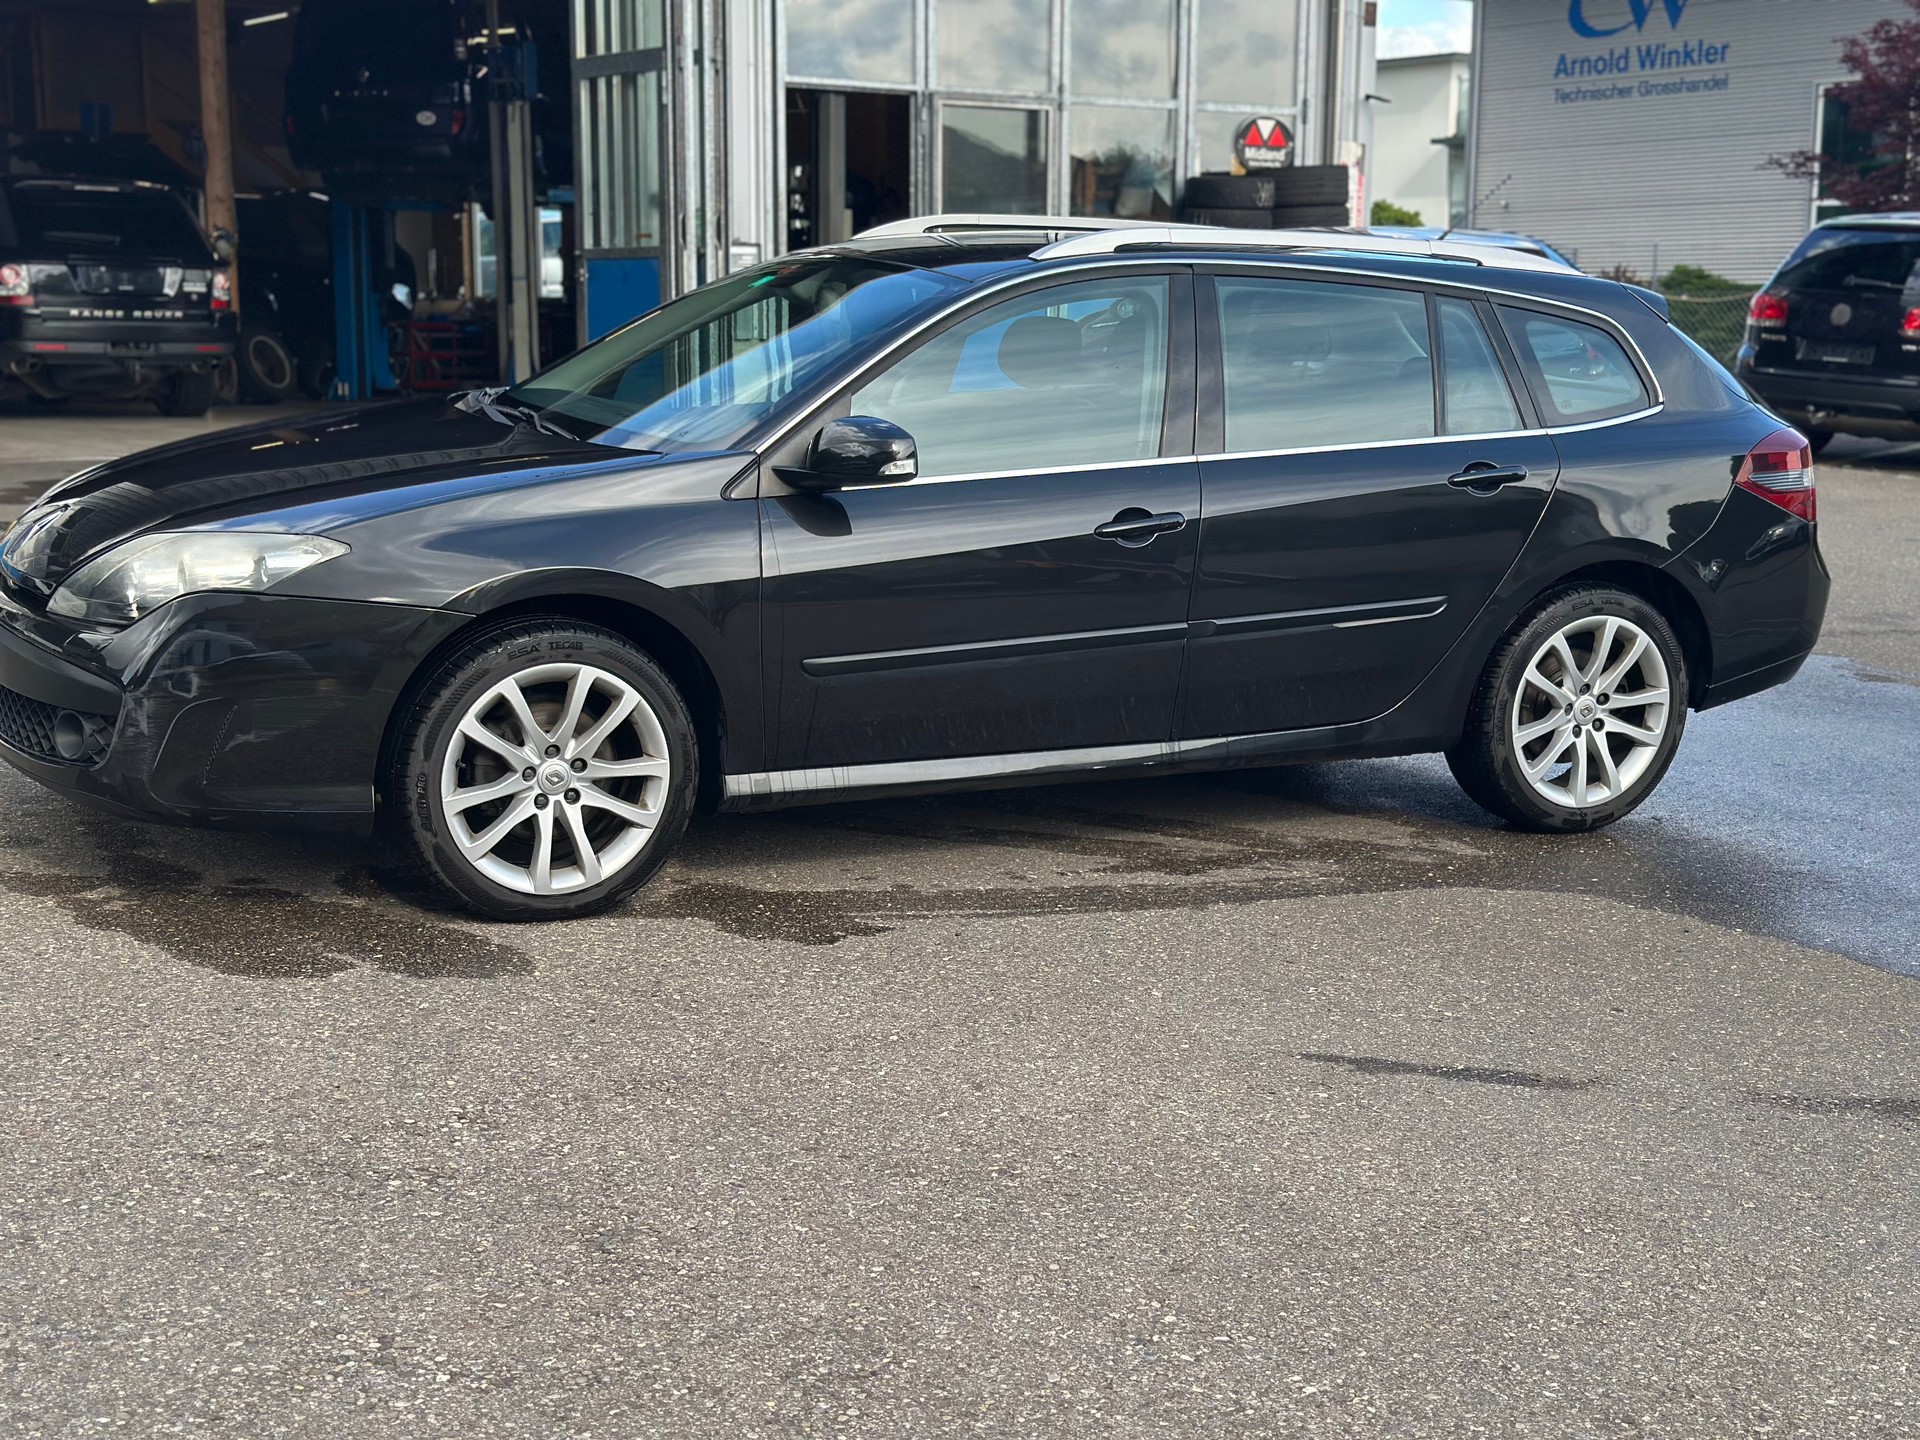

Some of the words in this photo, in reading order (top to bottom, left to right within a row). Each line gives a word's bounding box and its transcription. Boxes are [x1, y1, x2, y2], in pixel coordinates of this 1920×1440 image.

[1554, 47, 1631, 78] Arnold
[1636, 39, 1730, 71] Winkler
[1554, 83, 1634, 104] Technischer
[1638, 73, 1729, 97] Grosshandel
[69, 308, 125, 318] RANGE
[132, 310, 184, 319] ROVER
[416, 771, 427, 795] PRO
